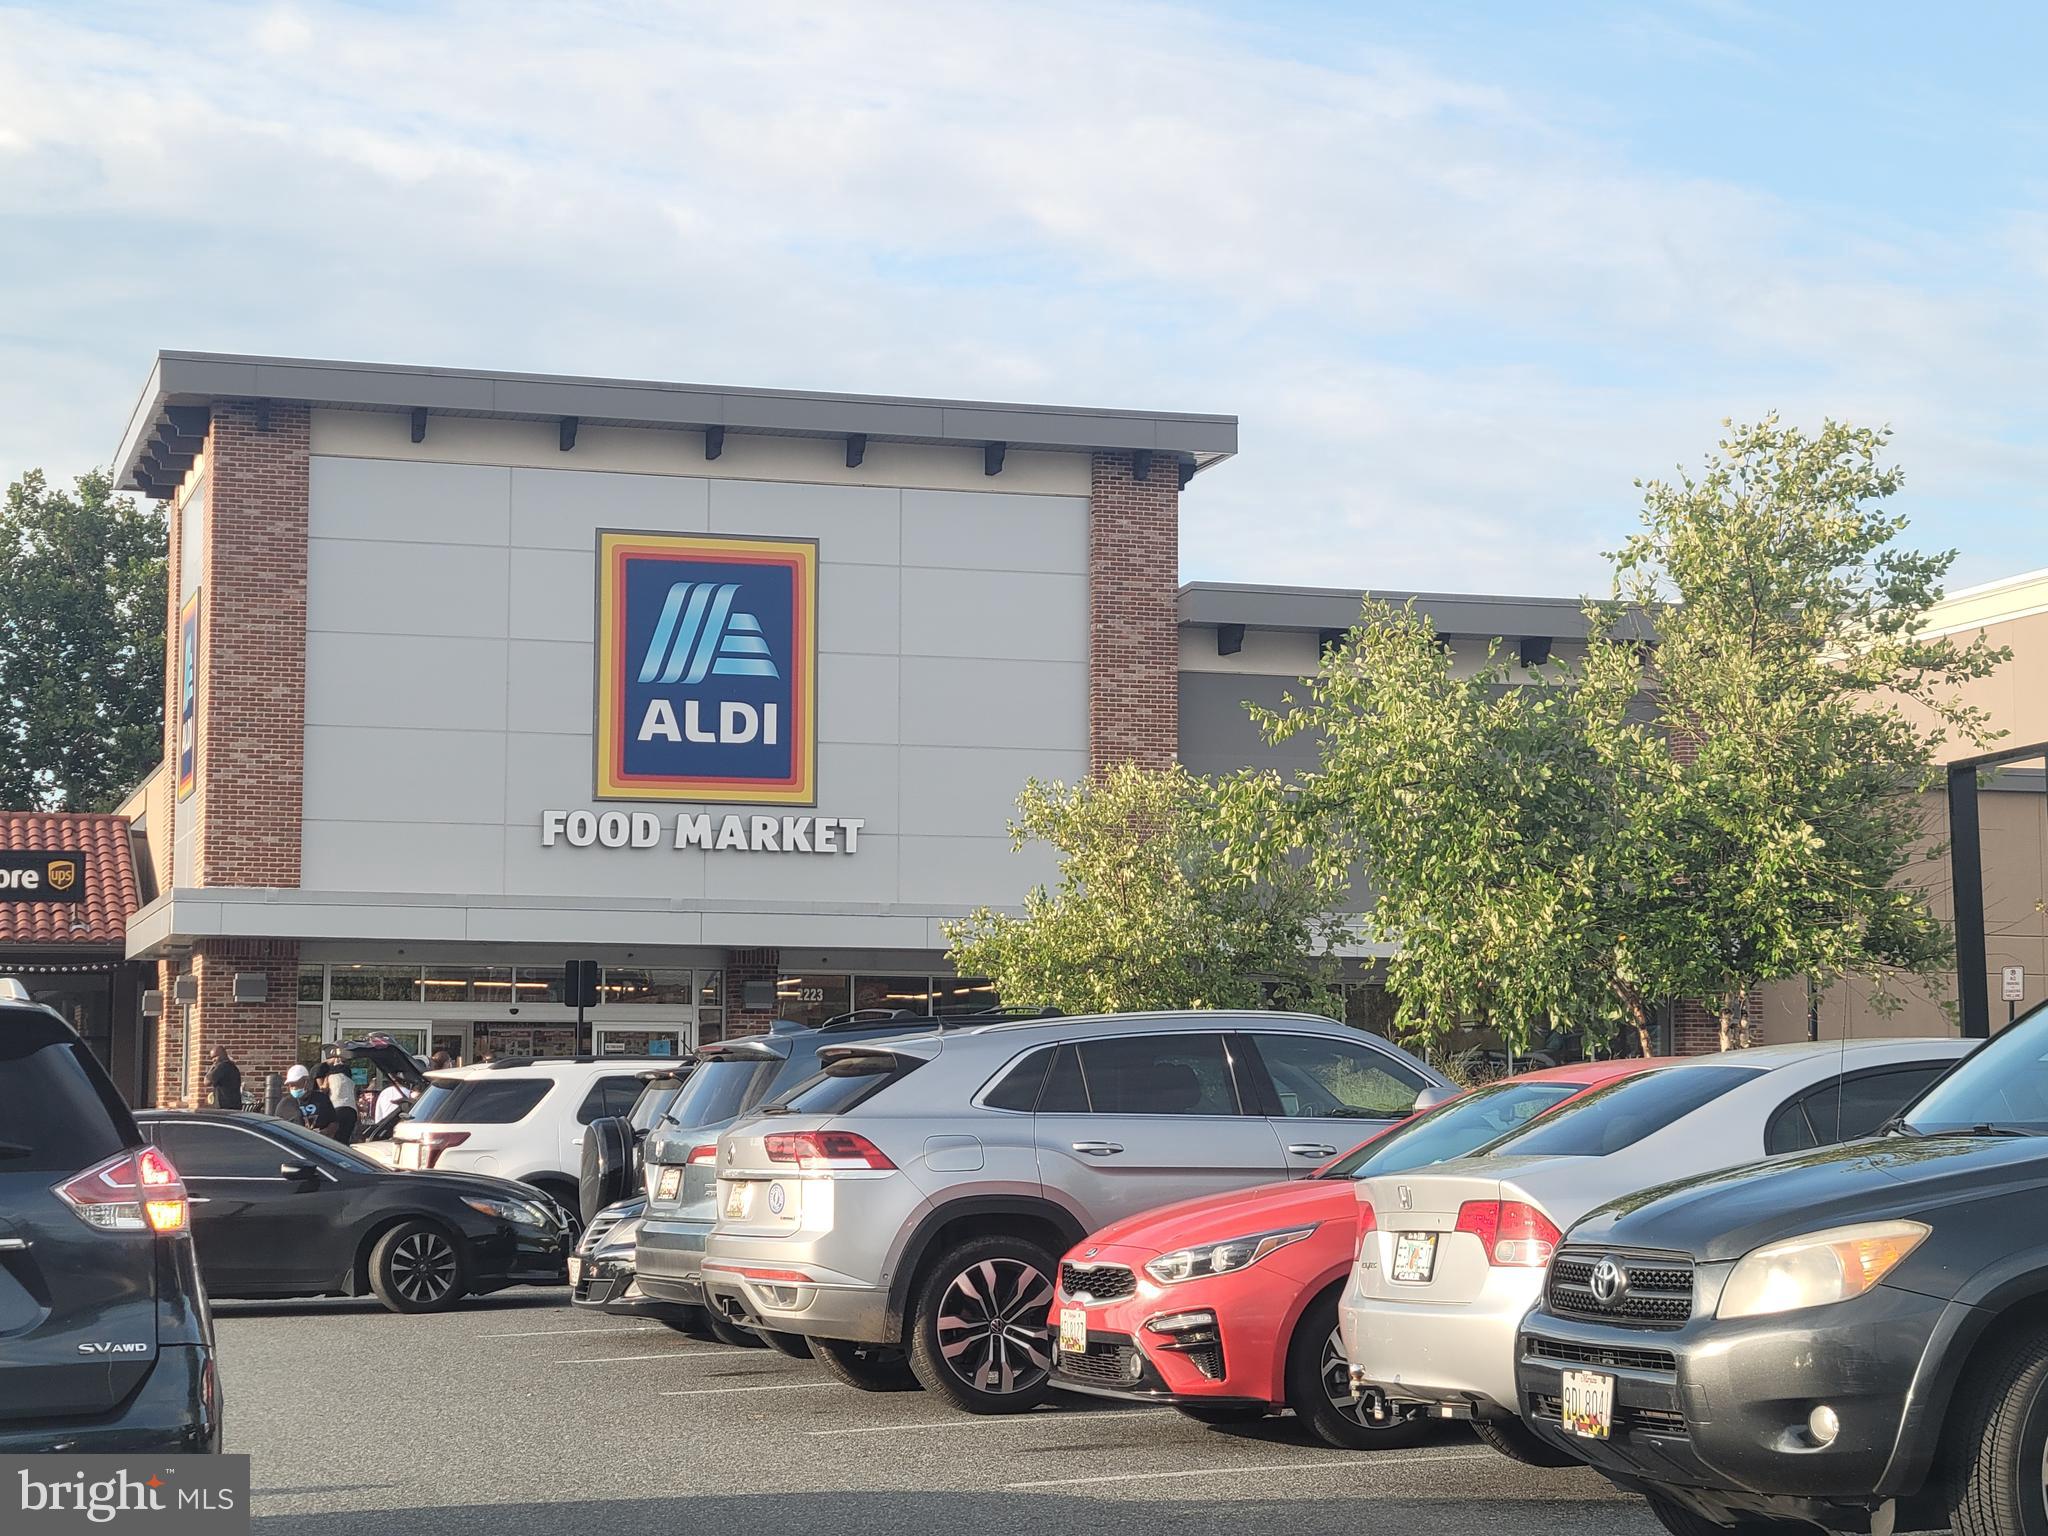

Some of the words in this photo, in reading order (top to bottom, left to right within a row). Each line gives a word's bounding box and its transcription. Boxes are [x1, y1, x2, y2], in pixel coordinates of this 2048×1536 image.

[637, 698, 777, 746] ALDI
[542, 809, 661, 848] FOOD
[673, 812, 865, 855] MARKET
[51, 870, 72, 885] ups
[797, 988, 824, 1002] 2223
